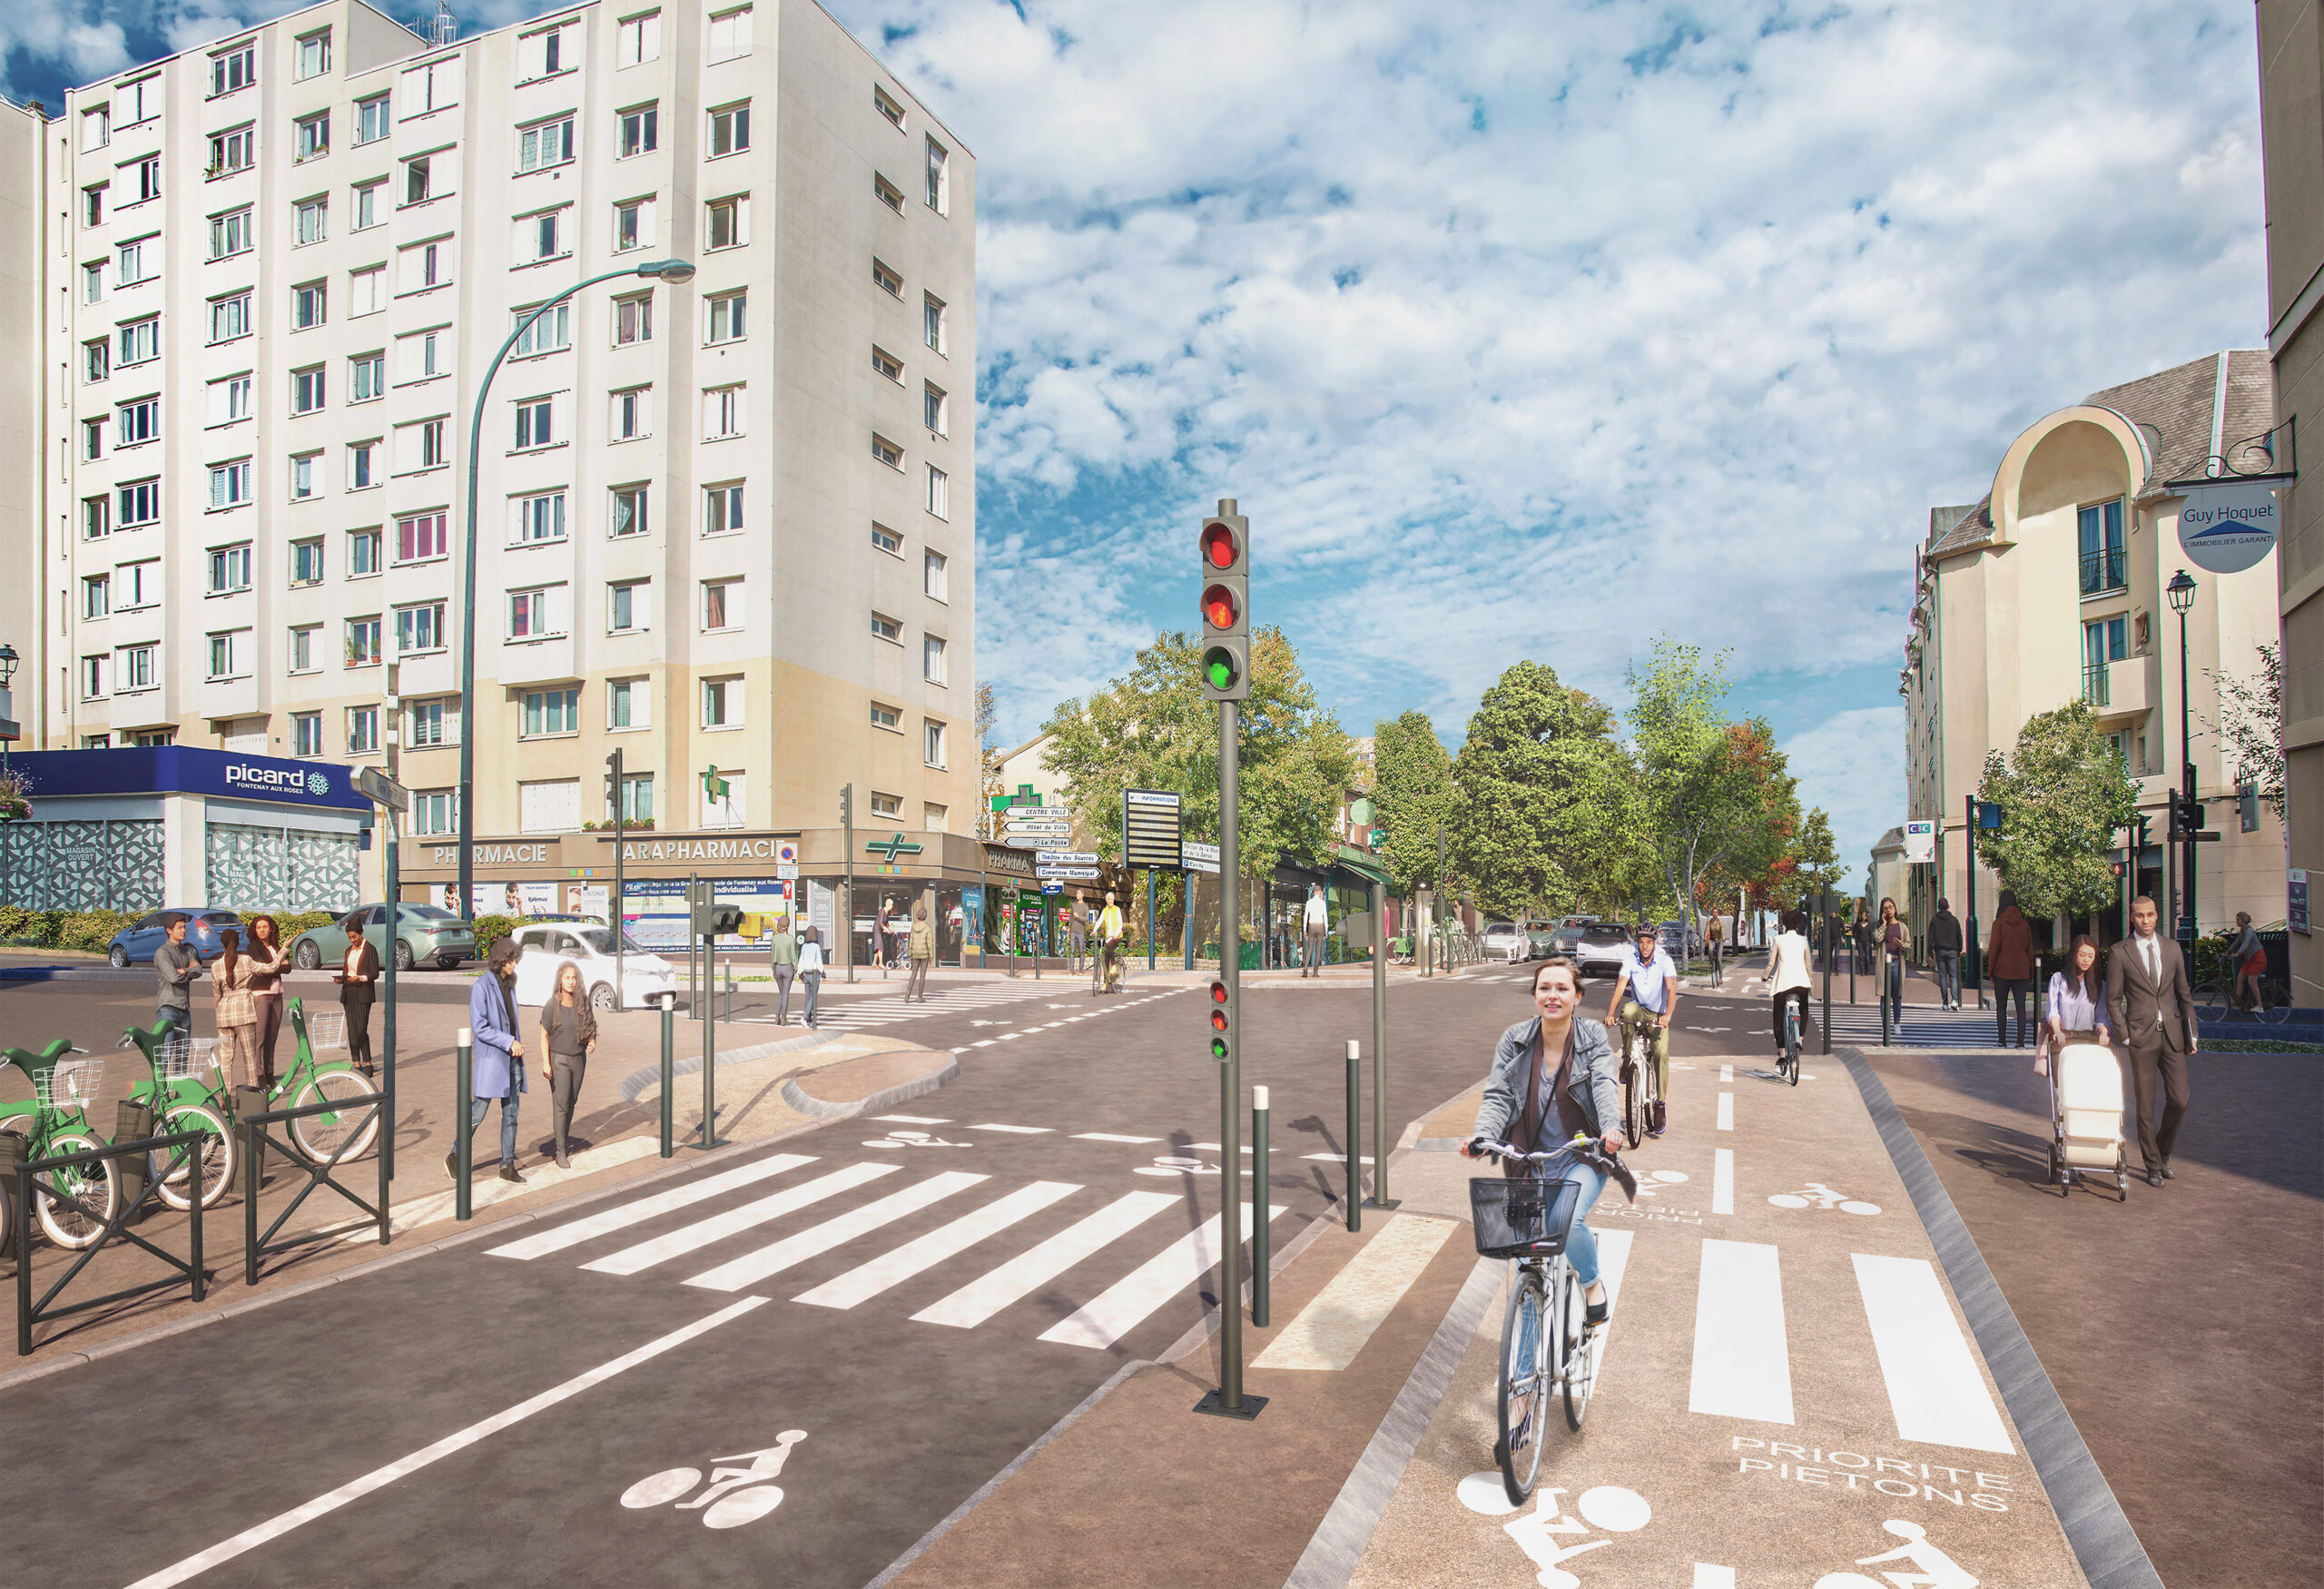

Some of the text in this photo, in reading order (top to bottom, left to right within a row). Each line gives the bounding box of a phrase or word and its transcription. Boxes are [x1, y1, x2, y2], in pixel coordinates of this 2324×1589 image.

[2184, 504, 2274, 524] Guy Hoquet
[2183, 535, 2274, 548] L'IMMOBILIER GARANTI
[225, 763, 304, 787] picard
[237, 782, 304, 794] FONTENAY AUX ROSES
[1141, 794, 1177, 804] INFORMATIONS
[1026, 823, 1042, 831] Hôtel
[1053, 823, 1068, 831] Ville
[1909, 824, 1929, 833] CIC
[66, 846, 95, 855] MAGASIN
[435, 844, 547, 864] PHRMACIE
[68, 854, 94, 862] OUVERT
[989, 850, 1035, 873] PHARMAC
[1068, 869, 1096, 877] Municipal
[1732, 1436, 2015, 1493] PRIORITE
[1738, 1457, 2009, 1514] PIETONS
